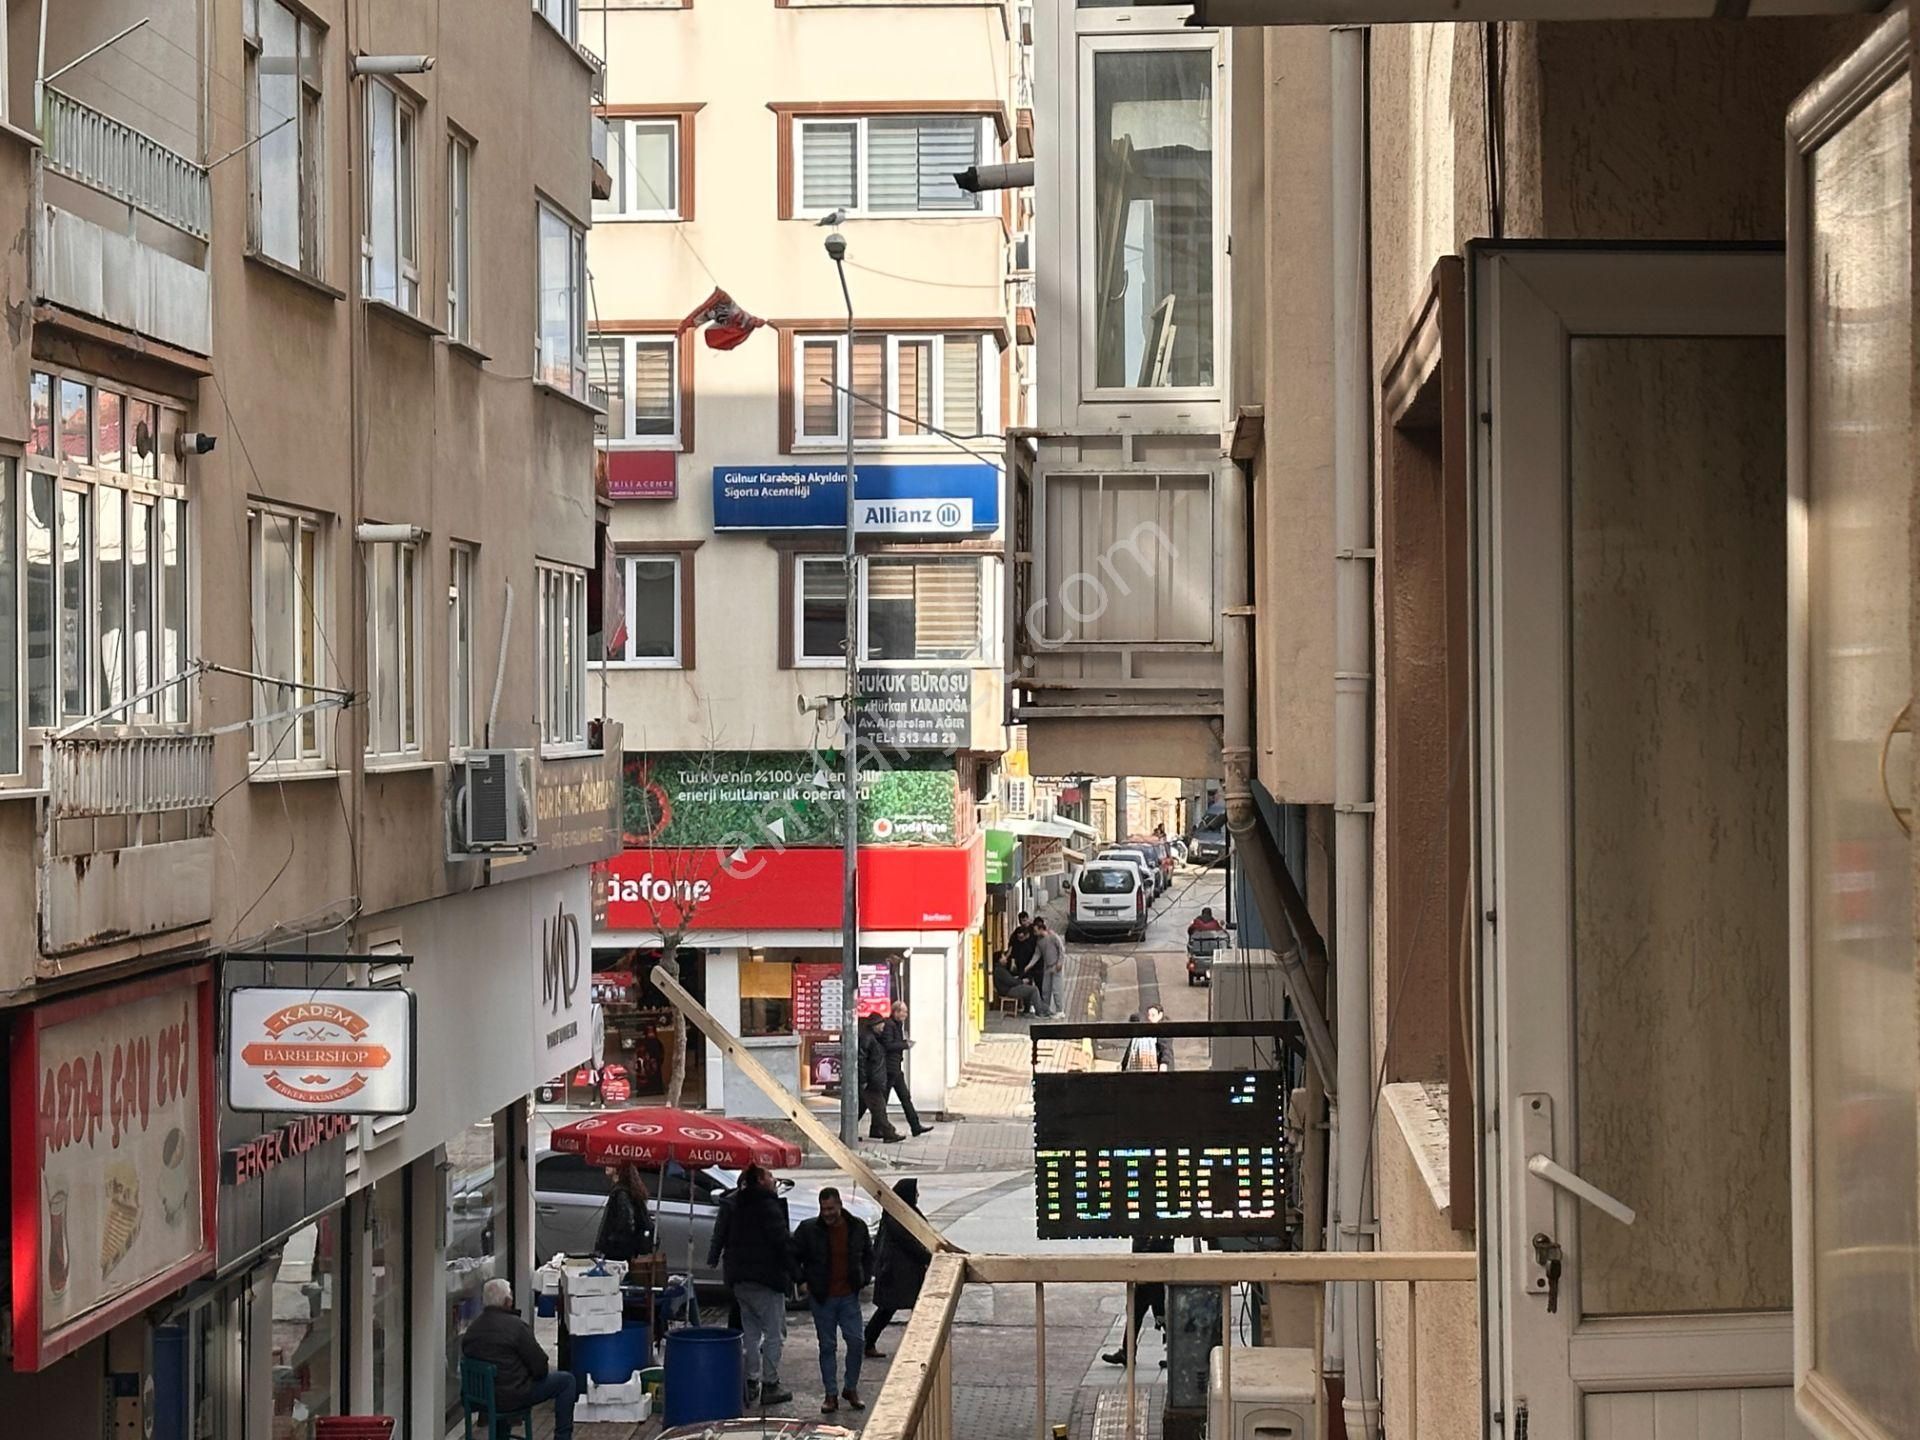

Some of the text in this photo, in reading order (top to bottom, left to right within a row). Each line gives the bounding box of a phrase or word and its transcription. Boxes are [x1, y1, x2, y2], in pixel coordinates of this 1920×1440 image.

[724, 472, 758, 484] Gülnur
[759, 472, 806, 485] Karaboğa
[724, 486, 810, 499] Sigorta Acenteliği
[865, 507, 932, 524] Allianz
[857, 670, 968, 692] HUKUK BÜROSU
[899, 732, 919, 744] 513
[754, 769, 793, 783] %100
[678, 788, 717, 804] enerji
[802, 787, 870, 804] operatrü
[280, 1005, 353, 1026] KADEM
[263, 1049, 369, 1063] BARBERSHOP
[110, 1034, 150, 1149] ÇAY
[236, 1129, 284, 1185] ERKEK
[604, 1144, 652, 1158] ALGIDA
[688, 1149, 733, 1163] ALGIDA
